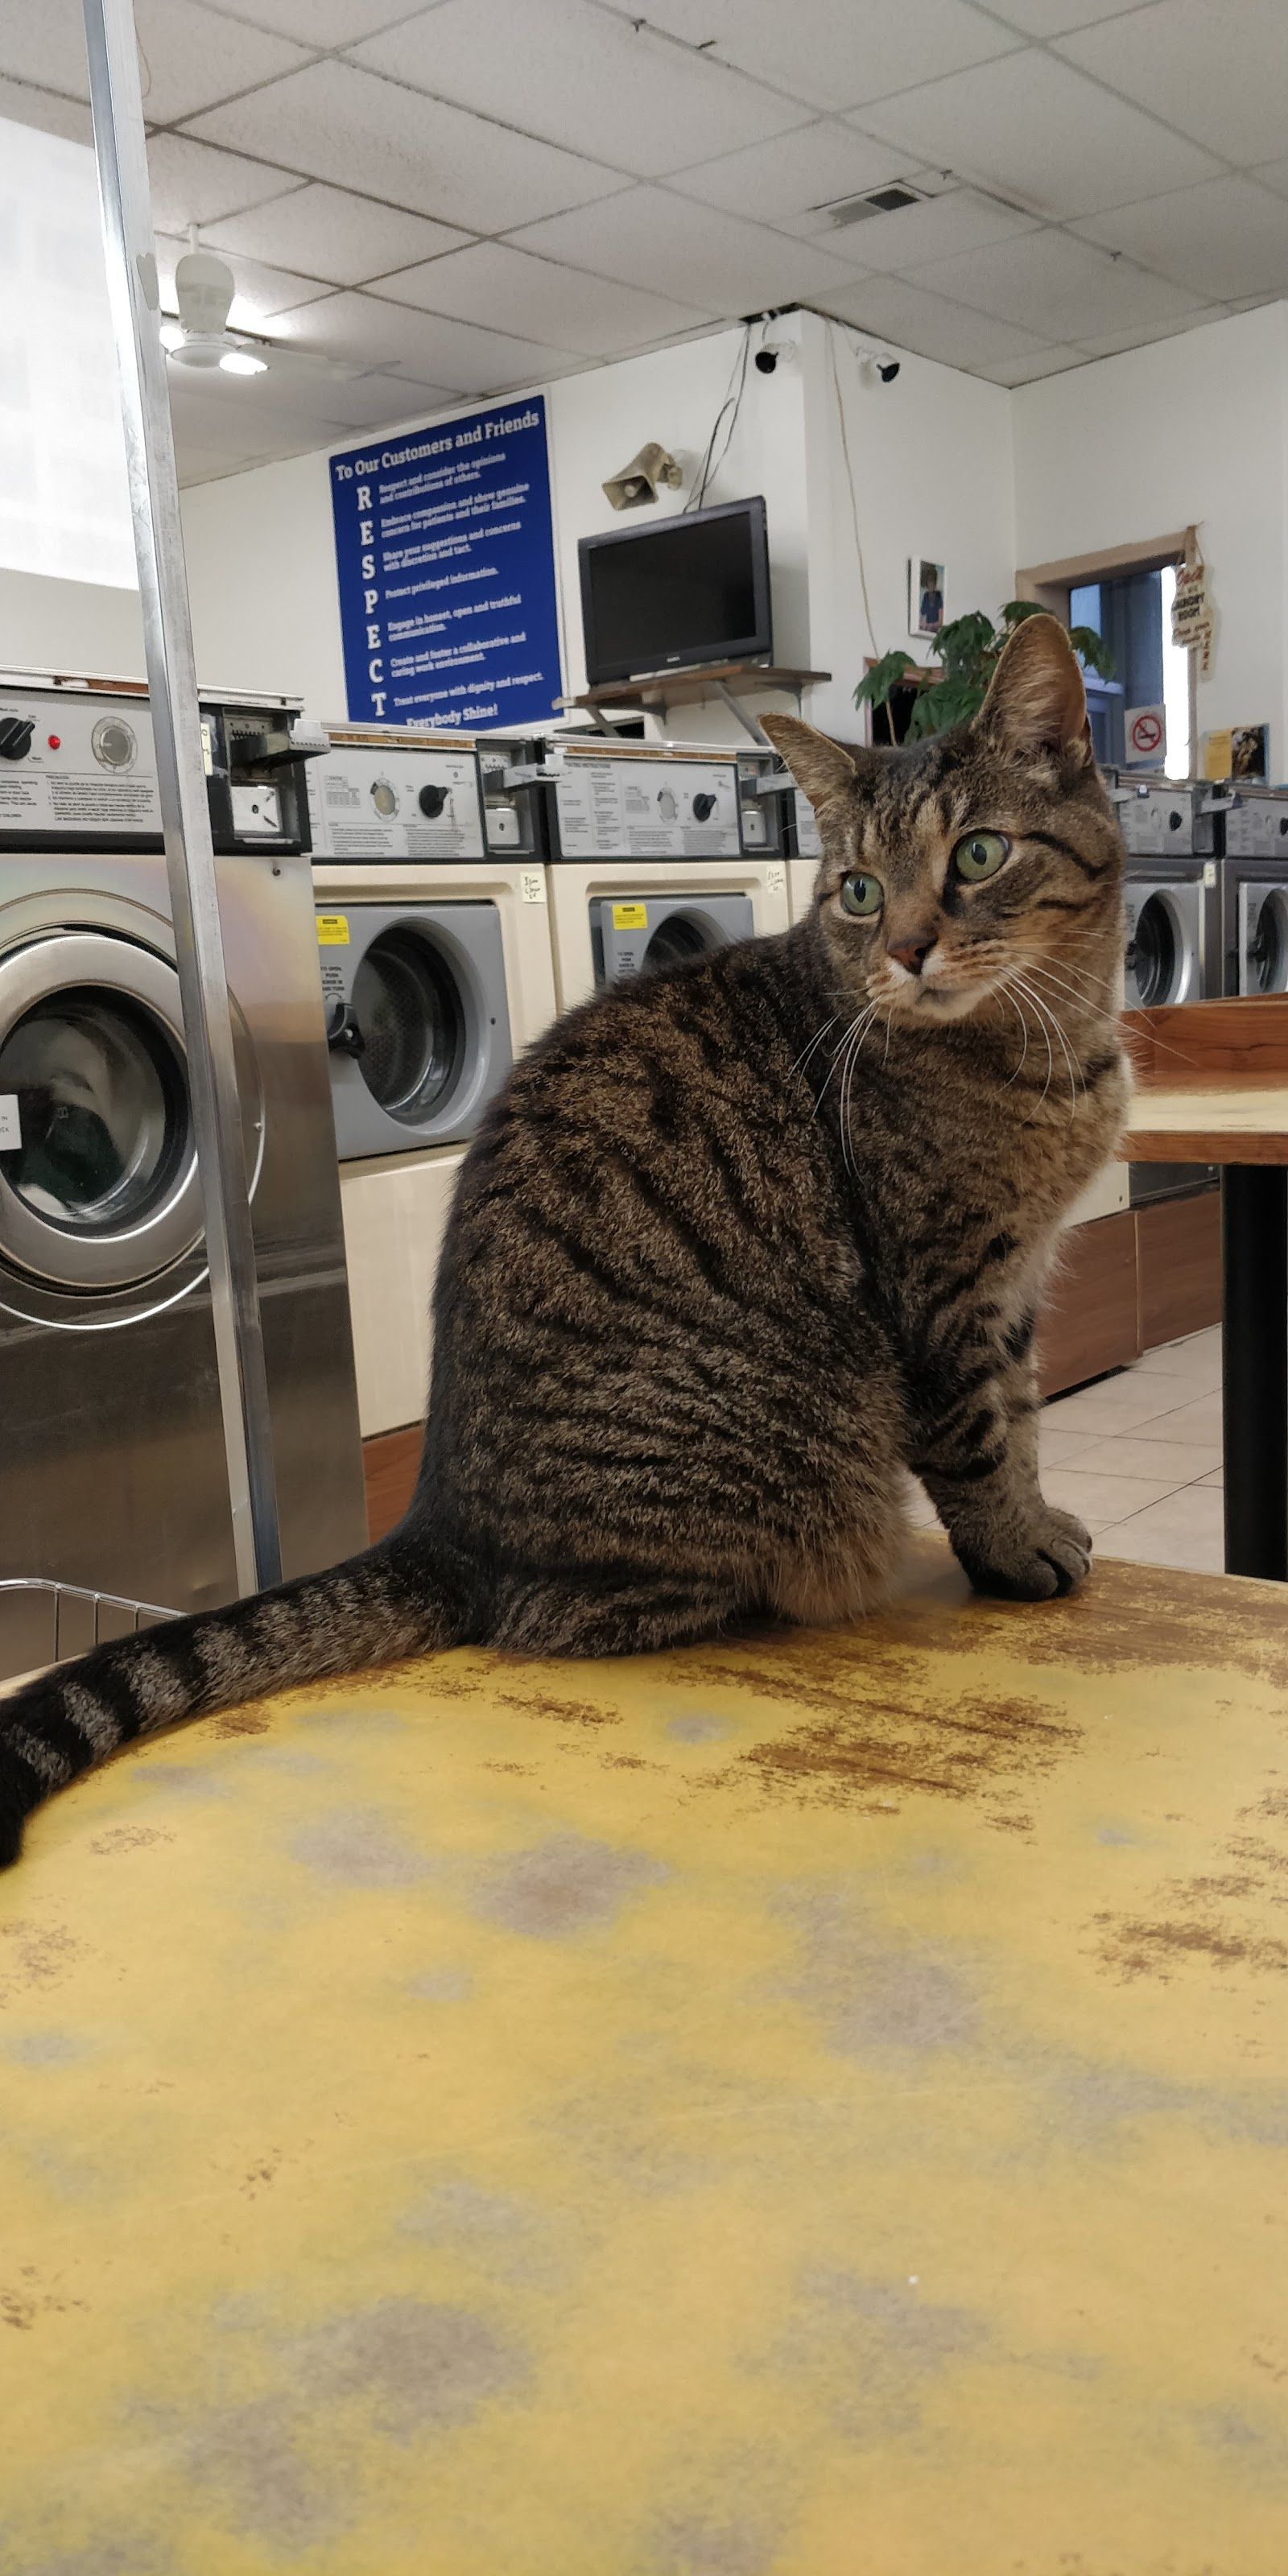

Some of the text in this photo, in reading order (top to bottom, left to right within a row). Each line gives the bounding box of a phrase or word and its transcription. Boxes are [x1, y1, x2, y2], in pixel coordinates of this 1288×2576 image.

[335, 410, 540, 481] To Our Customers and Friends
[408, 473, 423, 485] and
[423, 465, 456, 482] consider
[456, 462, 470, 473] the
[470, 452, 506, 470] opinions
[379, 489, 394, 504] and
[444, 476, 453, 487] of
[457, 494, 474, 508] and
[473, 492, 496, 505] show
[496, 483, 530, 500] genuine
[411, 521, 423, 531] for
[454, 506, 471, 520] and
[470, 502, 490, 515] their
[403, 546, 422, 559] your
[421, 533, 469, 552] suggestions
[467, 527, 485, 541] and
[484, 521, 522, 538] concerns
[383, 560, 401, 572] with
[437, 546, 455, 559] and
[411, 575, 450, 597] privileged
[415, 616, 424, 625] in
[452, 605, 473, 619] open
[473, 600, 489, 613] and
[489, 593, 522, 610] truthful
[390, 630, 526, 668] Create and foster a collaborative and
[390, 667, 416, 678] caring
[415, 660, 436, 674] work
[393, 696, 415, 708] Treat
[414, 690, 449, 704] everyone
[448, 684, 467, 697] with
[466, 681, 496, 695] dignity
[495, 676, 512, 689] and
[406, 702, 498, 728] Everybody Shine!
